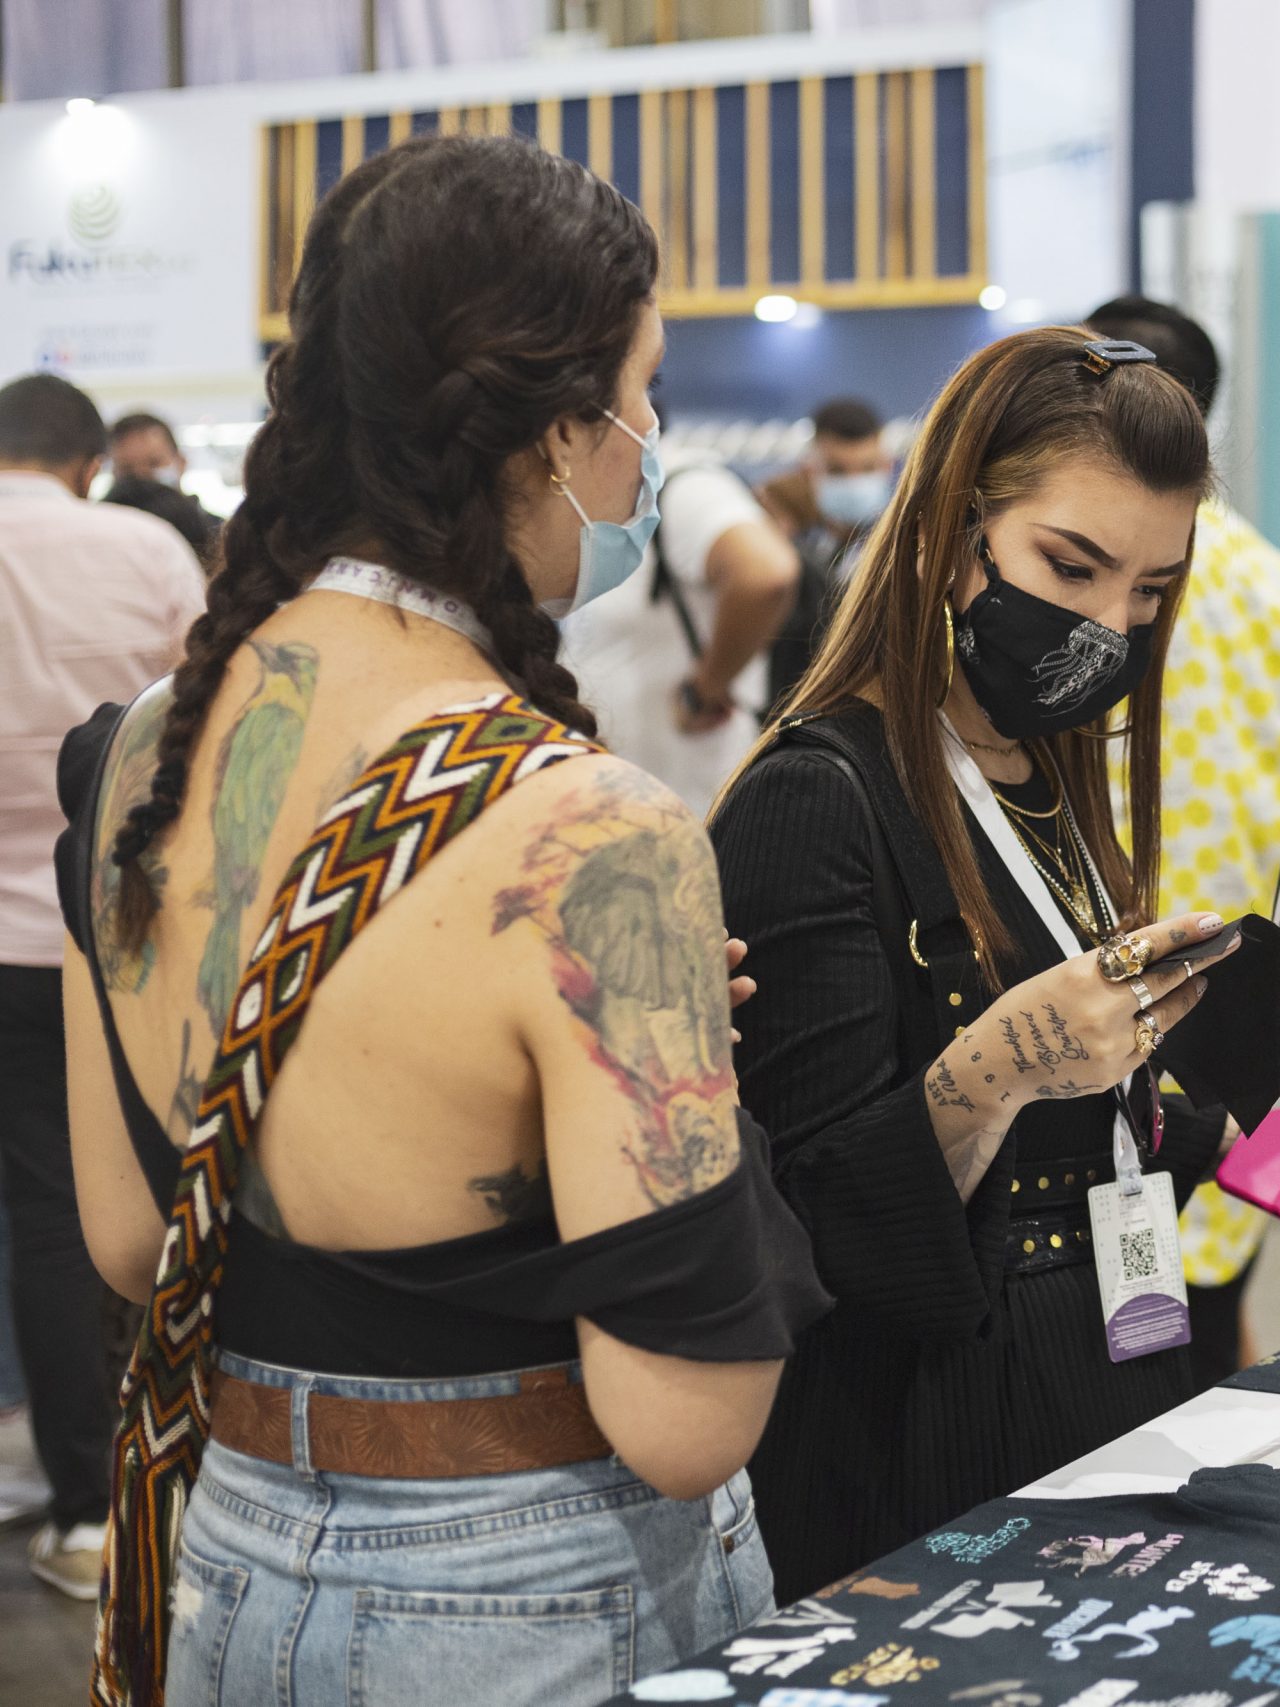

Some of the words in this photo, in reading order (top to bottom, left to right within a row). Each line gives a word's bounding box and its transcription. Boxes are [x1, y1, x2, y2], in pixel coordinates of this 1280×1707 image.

[999, 1016, 1036, 1074] Thankful
[1018, 1010, 1061, 1075] Blessed
[1042, 1003, 1089, 1060] Grateful
